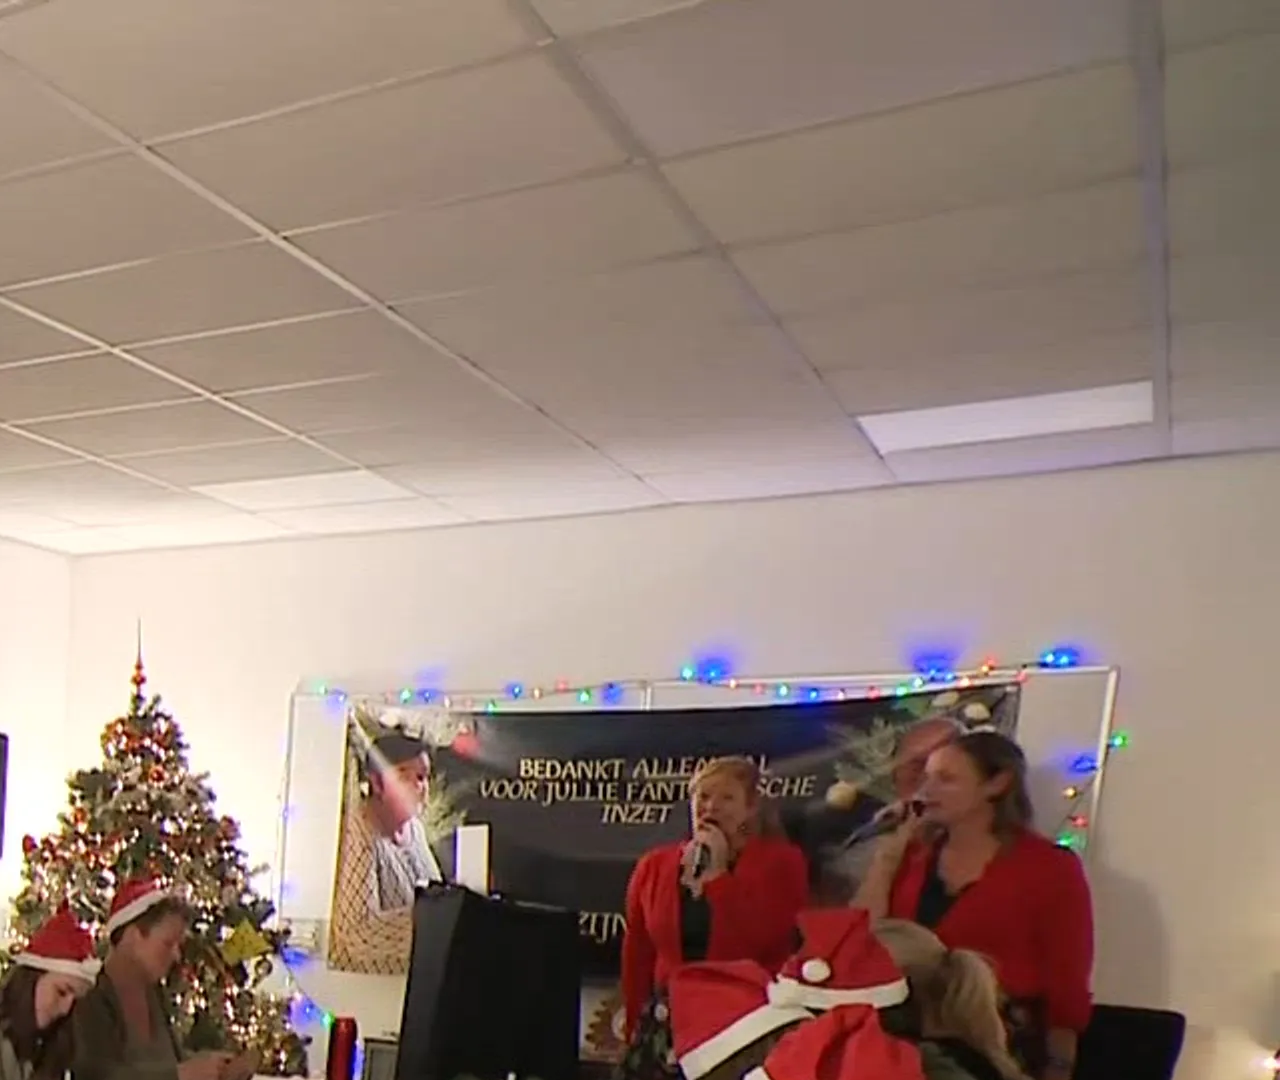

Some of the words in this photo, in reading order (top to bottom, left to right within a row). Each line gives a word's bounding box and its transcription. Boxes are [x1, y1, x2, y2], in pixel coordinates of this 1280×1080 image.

[519, 757, 626, 780] BEDANKT
[480, 778, 538, 801] VOOR
[542, 780, 619, 807] JULLIE
[601, 804, 674, 824] INZET
